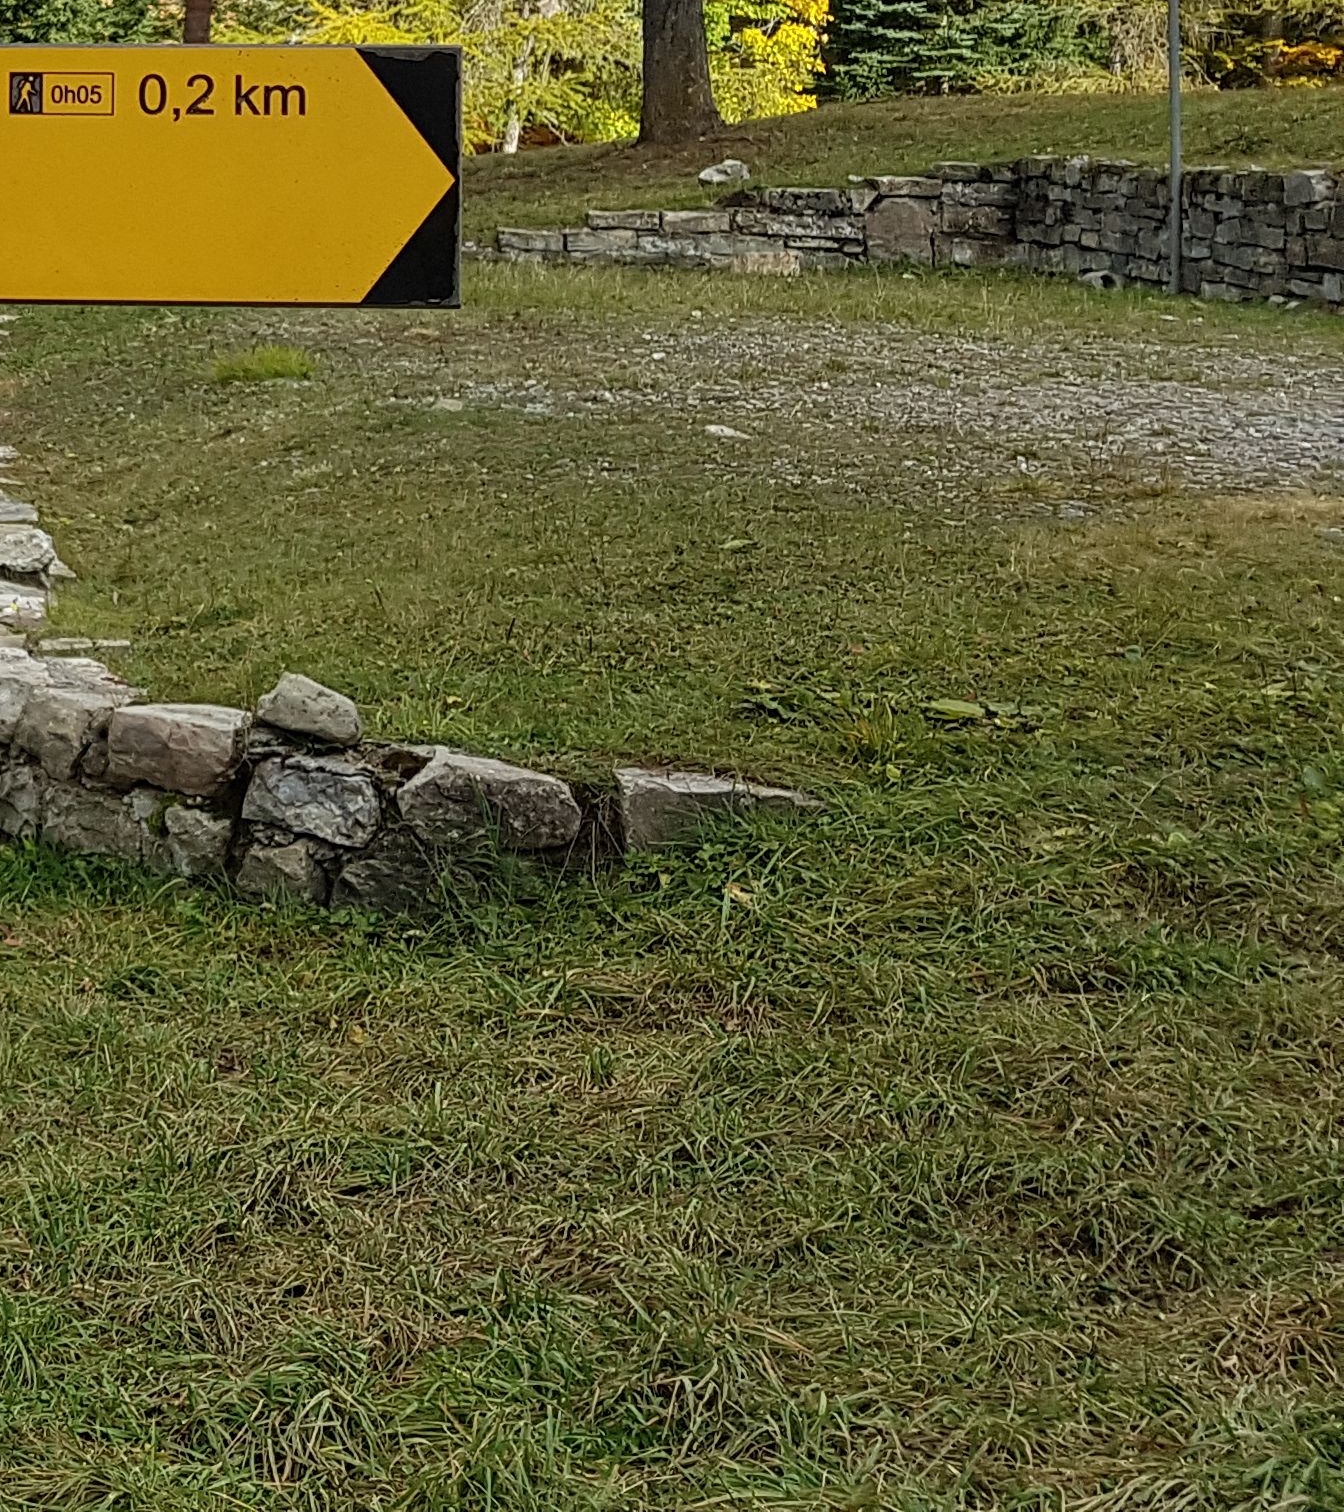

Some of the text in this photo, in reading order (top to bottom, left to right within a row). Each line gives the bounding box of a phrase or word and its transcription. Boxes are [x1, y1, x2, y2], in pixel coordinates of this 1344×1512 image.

[51, 84, 102, 105] 0h05
[138, 74, 306, 122] 0,2 km
